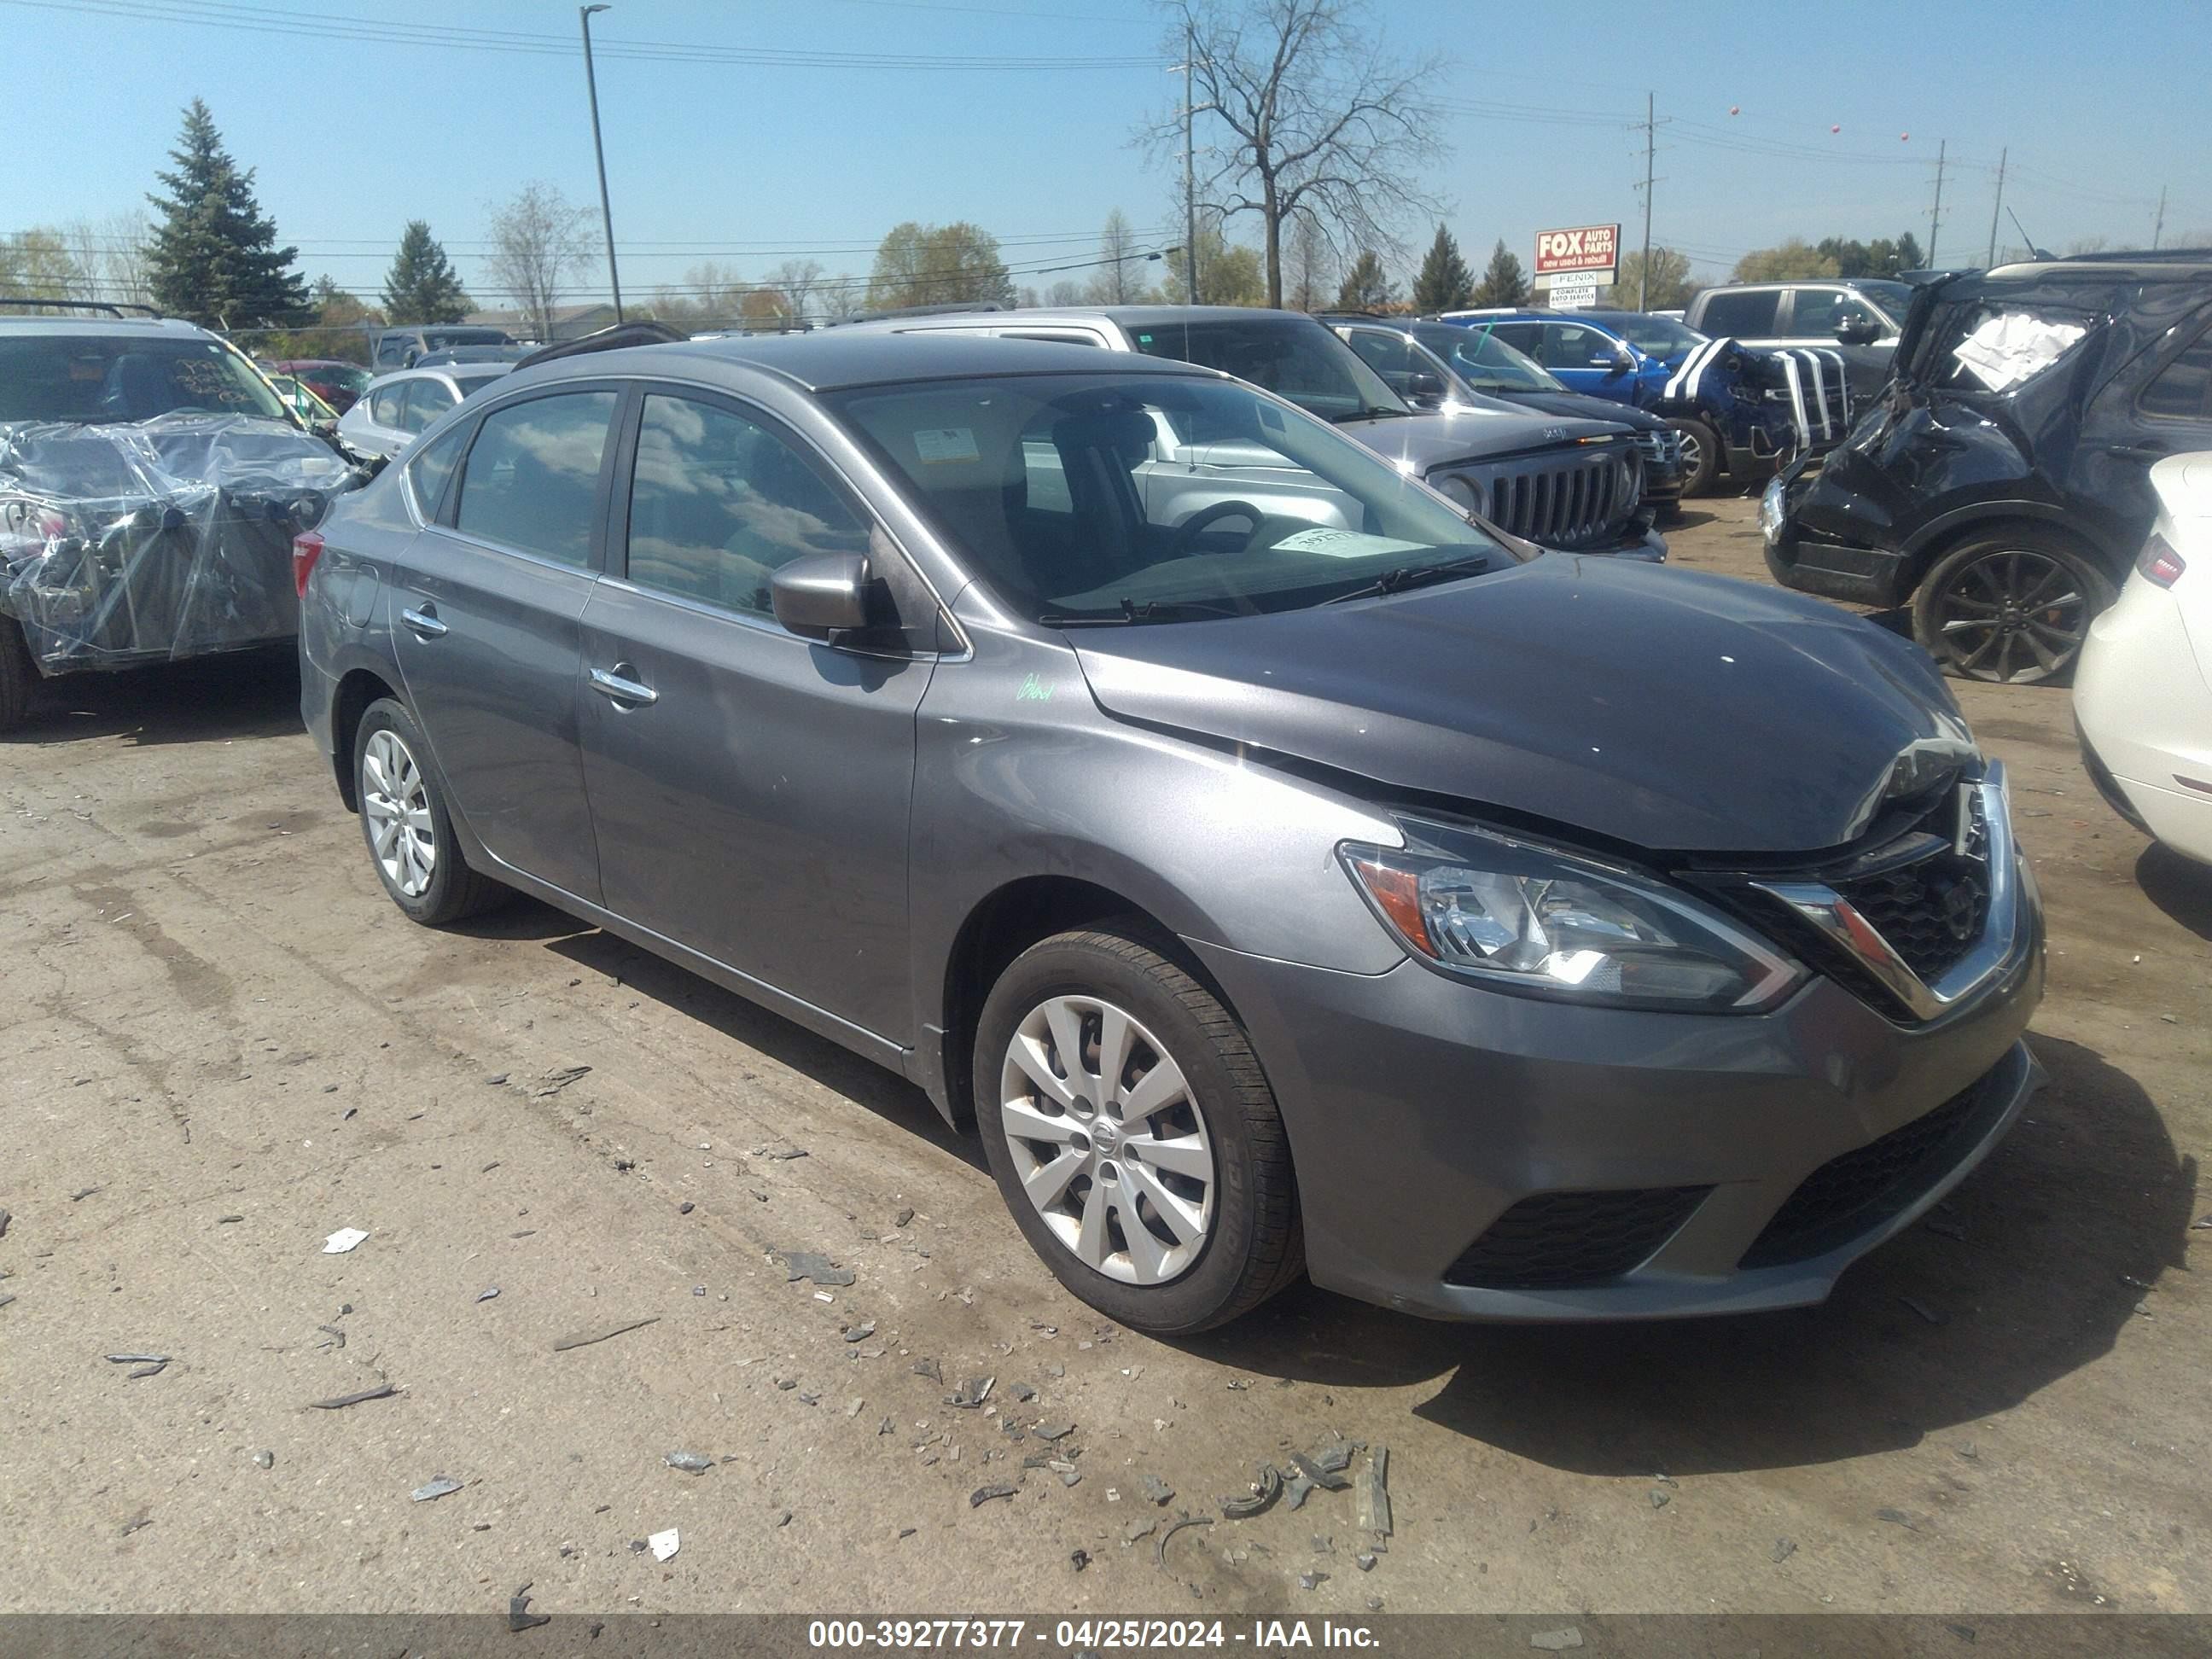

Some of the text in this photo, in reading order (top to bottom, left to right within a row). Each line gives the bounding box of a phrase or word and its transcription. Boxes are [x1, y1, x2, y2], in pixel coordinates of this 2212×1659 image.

[1586, 230, 1610, 242] AUTO
[1540, 232, 1583, 258] FOX
[1585, 241, 1612, 253] PARTS
[1543, 254, 1607, 268] new used & rebuilt
[1559, 273, 1595, 282] FENIX
